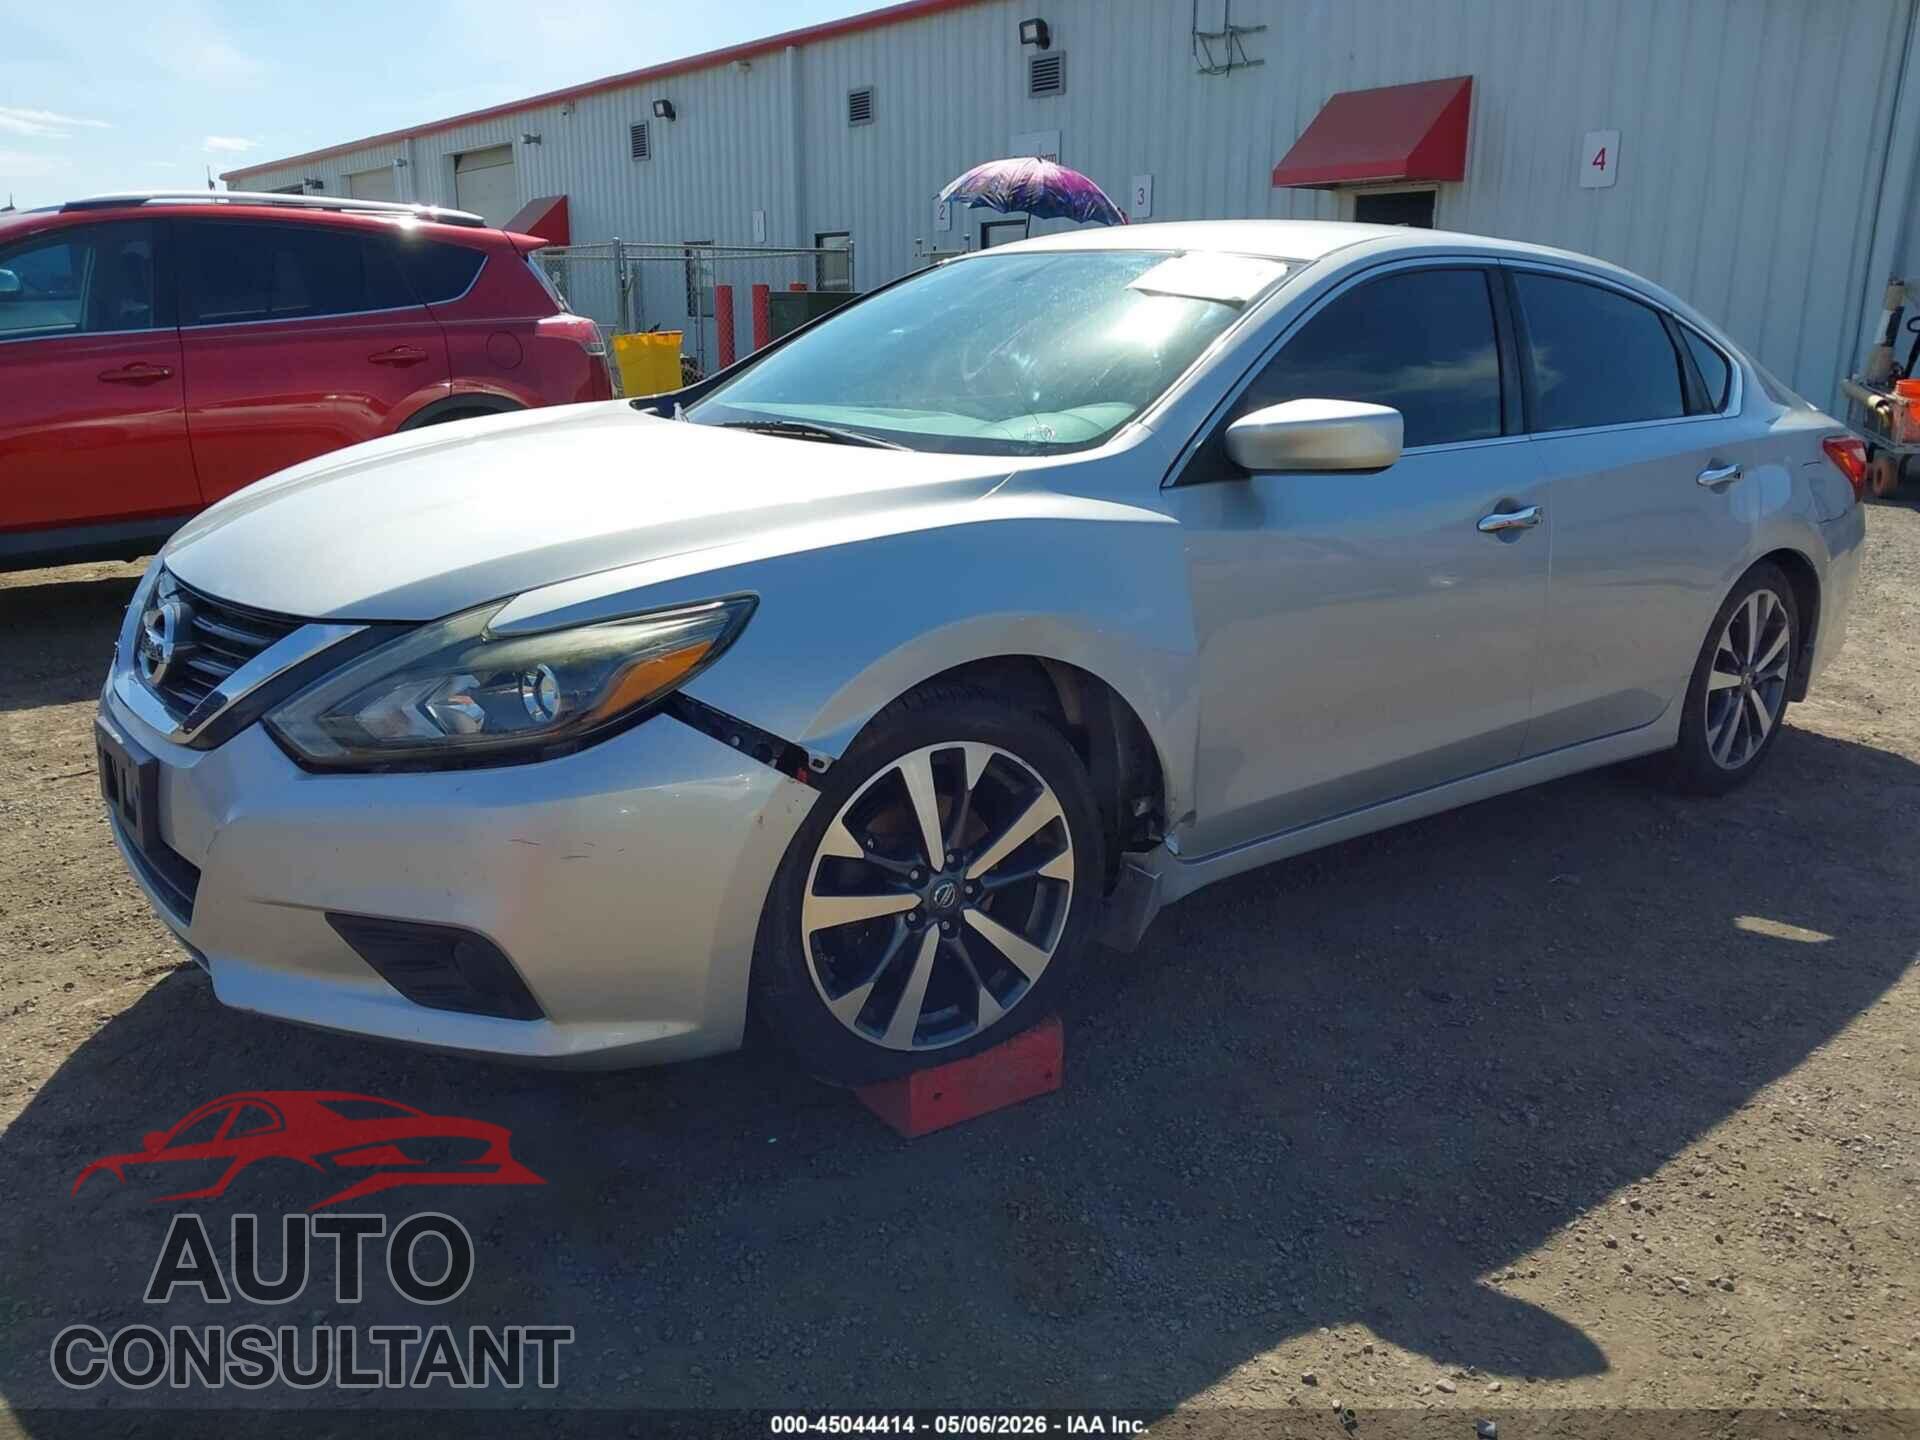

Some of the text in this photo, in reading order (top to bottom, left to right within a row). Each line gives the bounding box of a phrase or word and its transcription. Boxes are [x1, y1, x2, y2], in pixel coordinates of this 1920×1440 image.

[1592, 147, 1606, 171] 4
[1136, 187, 1145, 206] 3
[938, 204, 946, 220] 2
